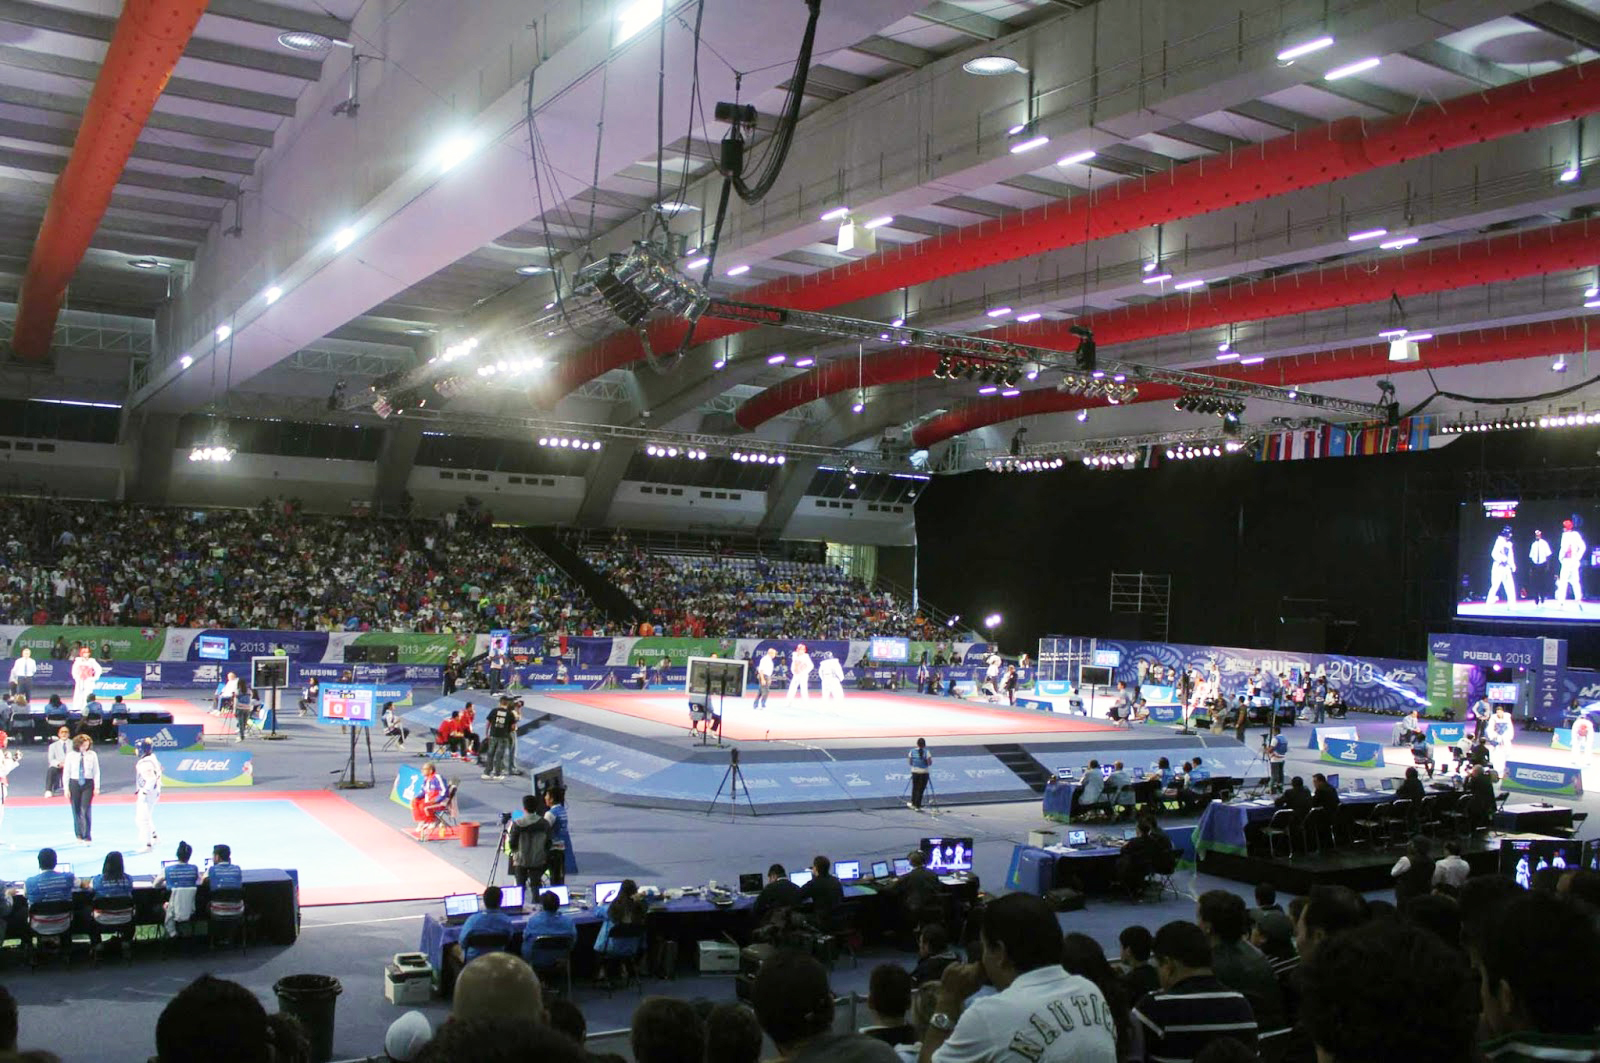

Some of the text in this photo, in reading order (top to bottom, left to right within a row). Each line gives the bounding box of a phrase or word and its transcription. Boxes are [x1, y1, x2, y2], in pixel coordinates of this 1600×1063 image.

[240, 642, 266, 652] 2013
[633, 648, 665, 656] PUEBLA
[1463, 650, 1531, 665] PUEBLA 2013
[36, 662, 53, 671] ebla
[300, 668, 338, 677] SAMSUNG
[1330, 661, 1373, 683] 2013
[102, 682, 127, 690] telcel
[375, 690, 401, 698] MSUNG
[333, 703, 361, 716] 0 0
[190, 758, 230, 771] telcel
[1009, 994, 1117, 1063] NAUTIC
